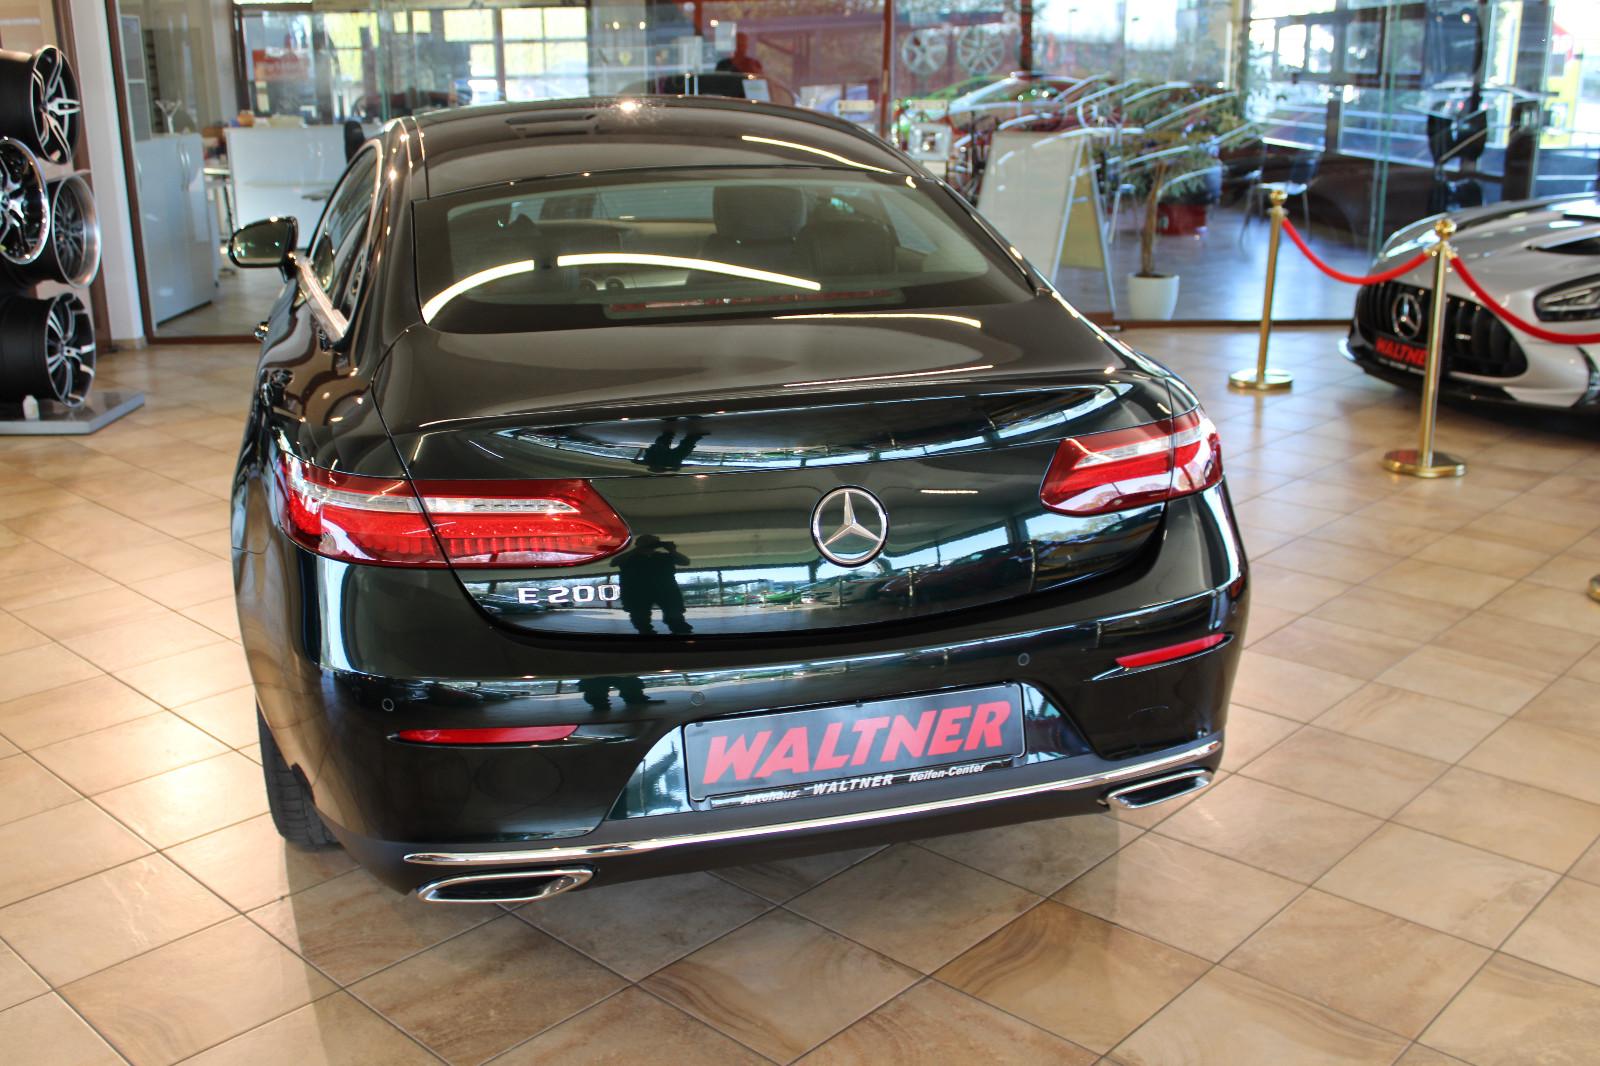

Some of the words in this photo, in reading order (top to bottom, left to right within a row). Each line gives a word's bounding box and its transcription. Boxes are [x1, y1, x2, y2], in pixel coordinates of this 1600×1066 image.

[1375, 336, 1428, 366] WALTNE
[517, 587, 539, 604] E
[547, 584, 621, 604] 200
[703, 701, 1011, 785] WALTNER
[740, 788, 798, 805] Autohaus
[812, 773, 894, 796] WALTNER
[908, 762, 987, 783] Reifen-Center
